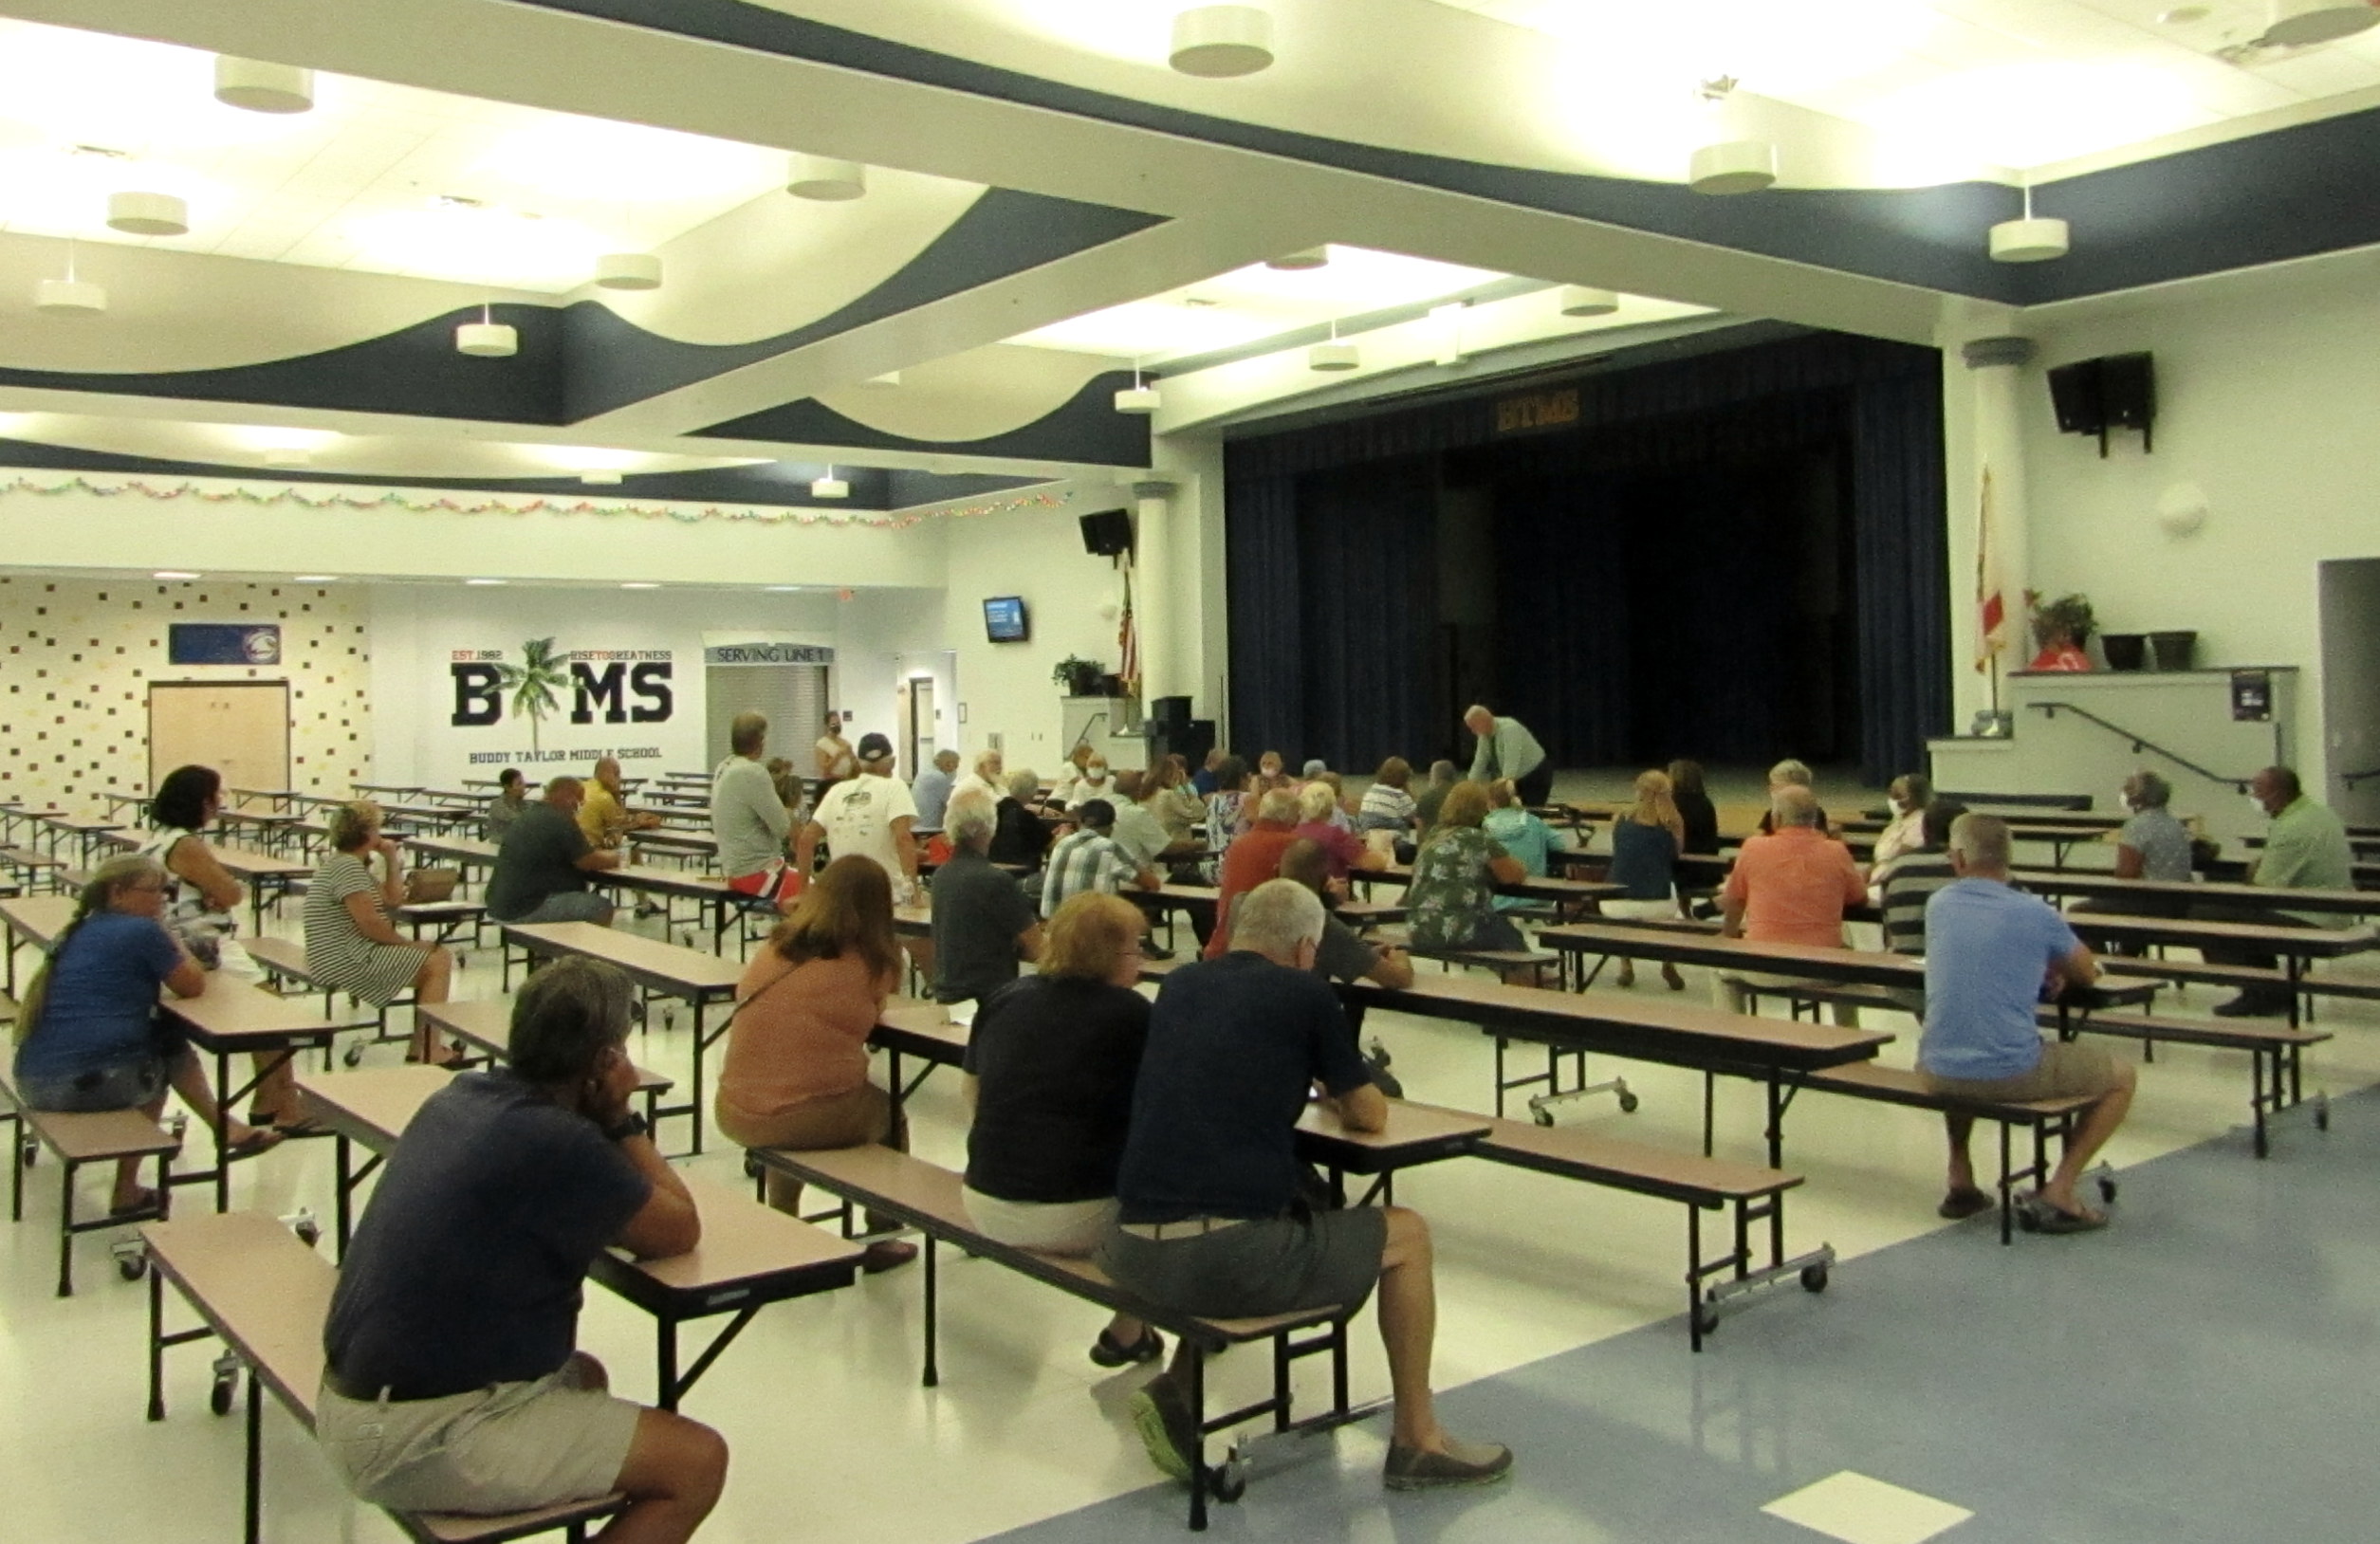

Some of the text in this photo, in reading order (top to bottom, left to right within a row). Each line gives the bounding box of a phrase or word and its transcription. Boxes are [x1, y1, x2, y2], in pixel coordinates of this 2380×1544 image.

[717, 647, 780, 663] SERVING
[784, 648, 816, 663] LINE
[469, 752, 511, 764] BUDDY
[515, 750, 566, 763] TAYLOR
[617, 746, 663, 760] SCHOOL
